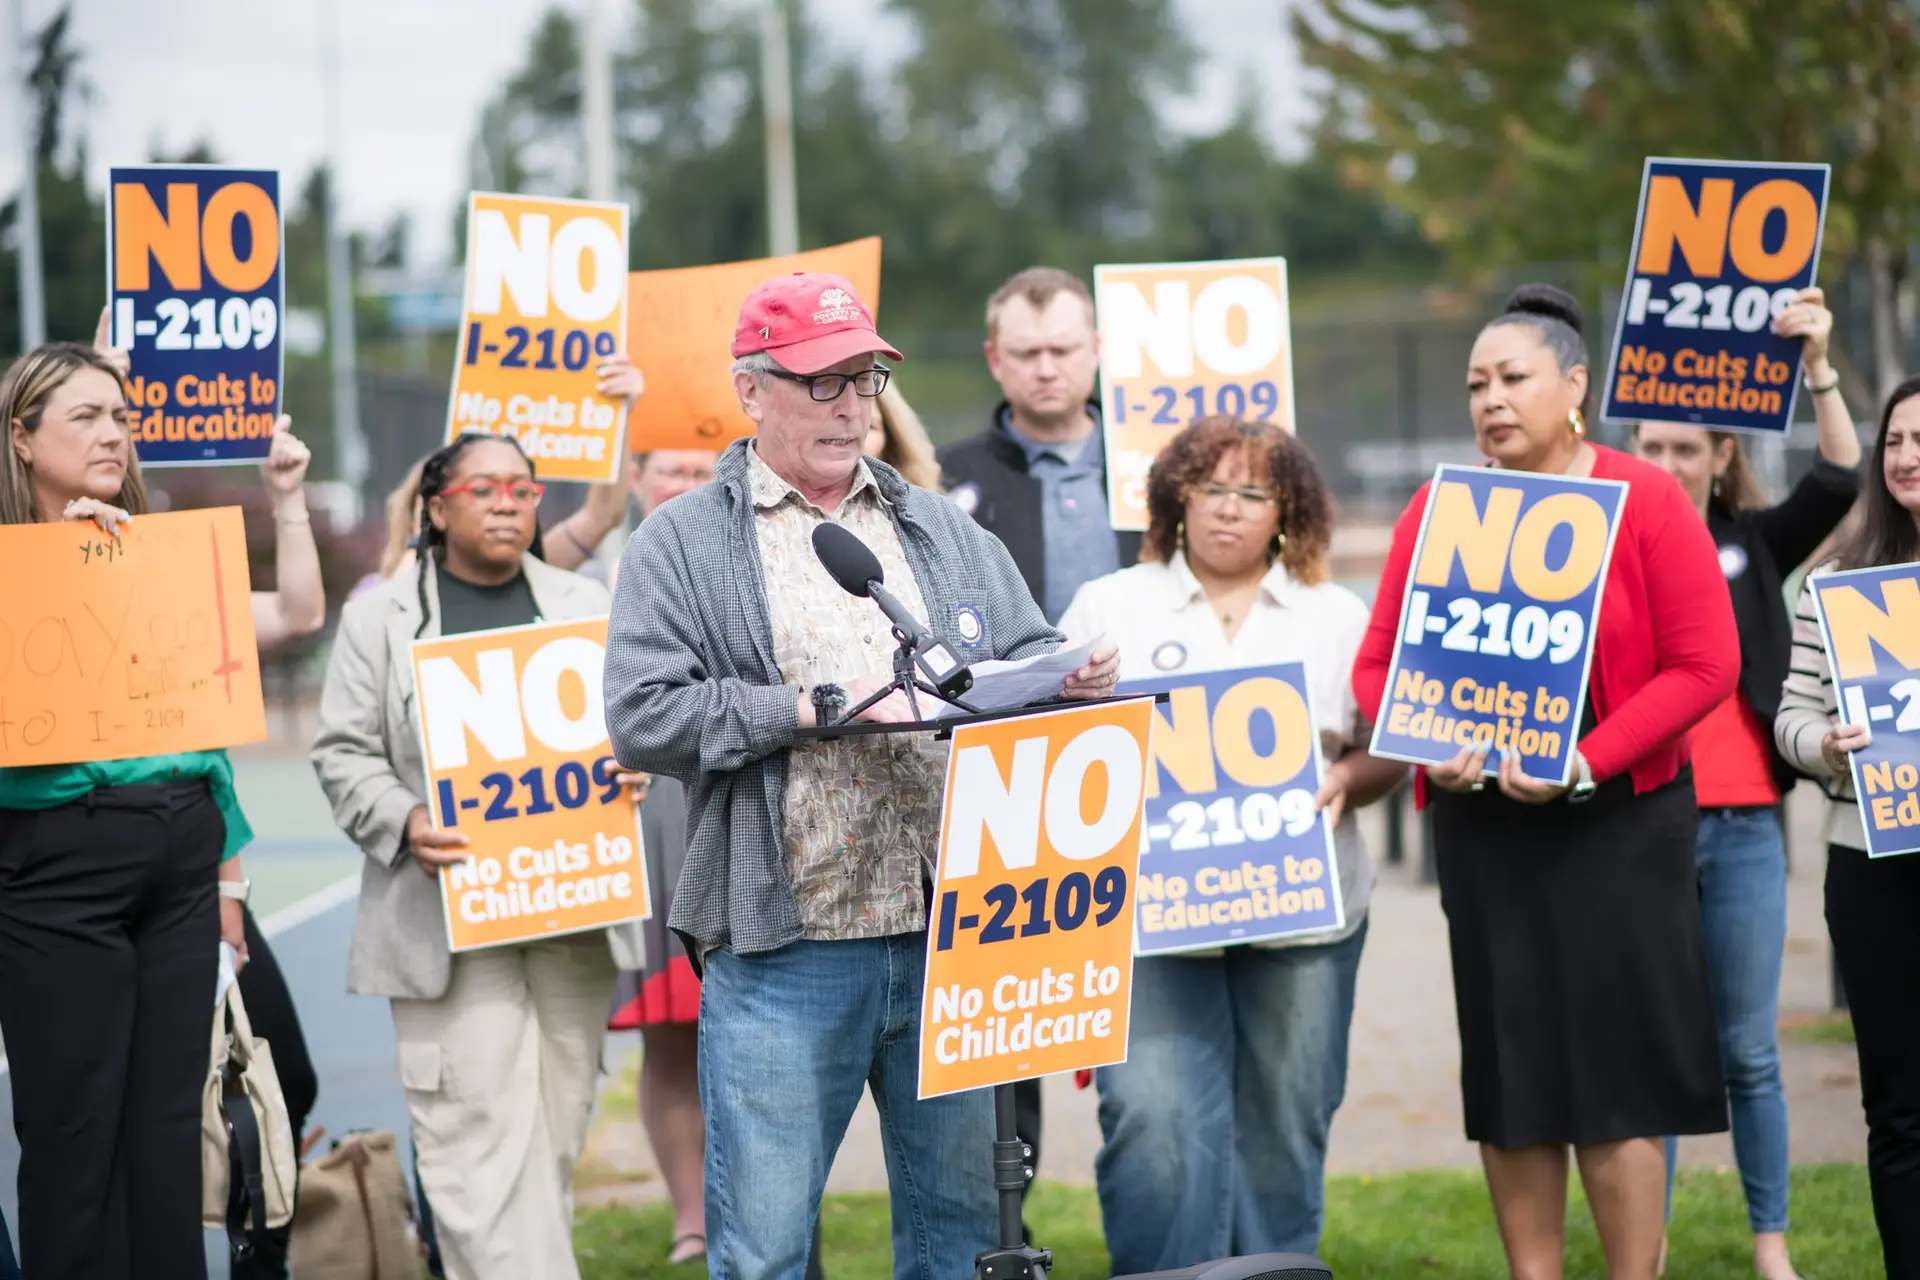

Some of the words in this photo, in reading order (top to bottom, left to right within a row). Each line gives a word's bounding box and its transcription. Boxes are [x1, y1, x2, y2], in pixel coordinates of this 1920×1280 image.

[114, 181, 279, 292] NO
[1636, 175, 1817, 283] NO
[470, 209, 623, 323] NO
[116, 297, 277, 350] I-2109
[1106, 275, 1279, 378] NO
[125, 375, 168, 407] No
[175, 372, 246, 407] Cuts
[250, 371, 276, 405] to
[1619, 344, 1667, 375] No
[1672, 348, 1748, 380] Cuts
[1754, 352, 1790, 385] to
[457, 391, 501, 423] No
[506, 394, 575, 428] Cuts
[579, 396, 614, 429] to
[1113, 381, 1279, 424] I-2109
[1615, 374, 1782, 415] Education
[127, 405, 275, 442] Education
[459, 422, 606, 461] dcare
[1414, 481, 1608, 602] NO
[1403, 590, 1584, 665] I-2109
[1820, 577, 1920, 680] N
[418, 636, 610, 770] NO
[1393, 668, 1444, 706] No
[1451, 677, 1528, 718] Cuts
[1534, 686, 1570, 723] to
[1844, 677, 1920, 745] I-2
[1147, 677, 1313, 799] NO
[1386, 702, 1561, 760] Education
[944, 724, 1142, 880] NO
[1862, 760, 1919, 795] No
[451, 854, 502, 889] No
[508, 838, 591, 878] Cuts
[594, 832, 633, 866] to
[1138, 873, 1188, 902] No
[1195, 861, 1279, 896] Cuts
[1283, 854, 1324, 885] to
[459, 870, 632, 924] Childcare
[936, 865, 1127, 952] I-2109
[1141, 886, 1326, 933] Education
[931, 984, 983, 1024] No
[993, 967, 1075, 1012] Cuts
[1083, 959, 1120, 998] to
[935, 1008, 1112, 1065] Childcare
